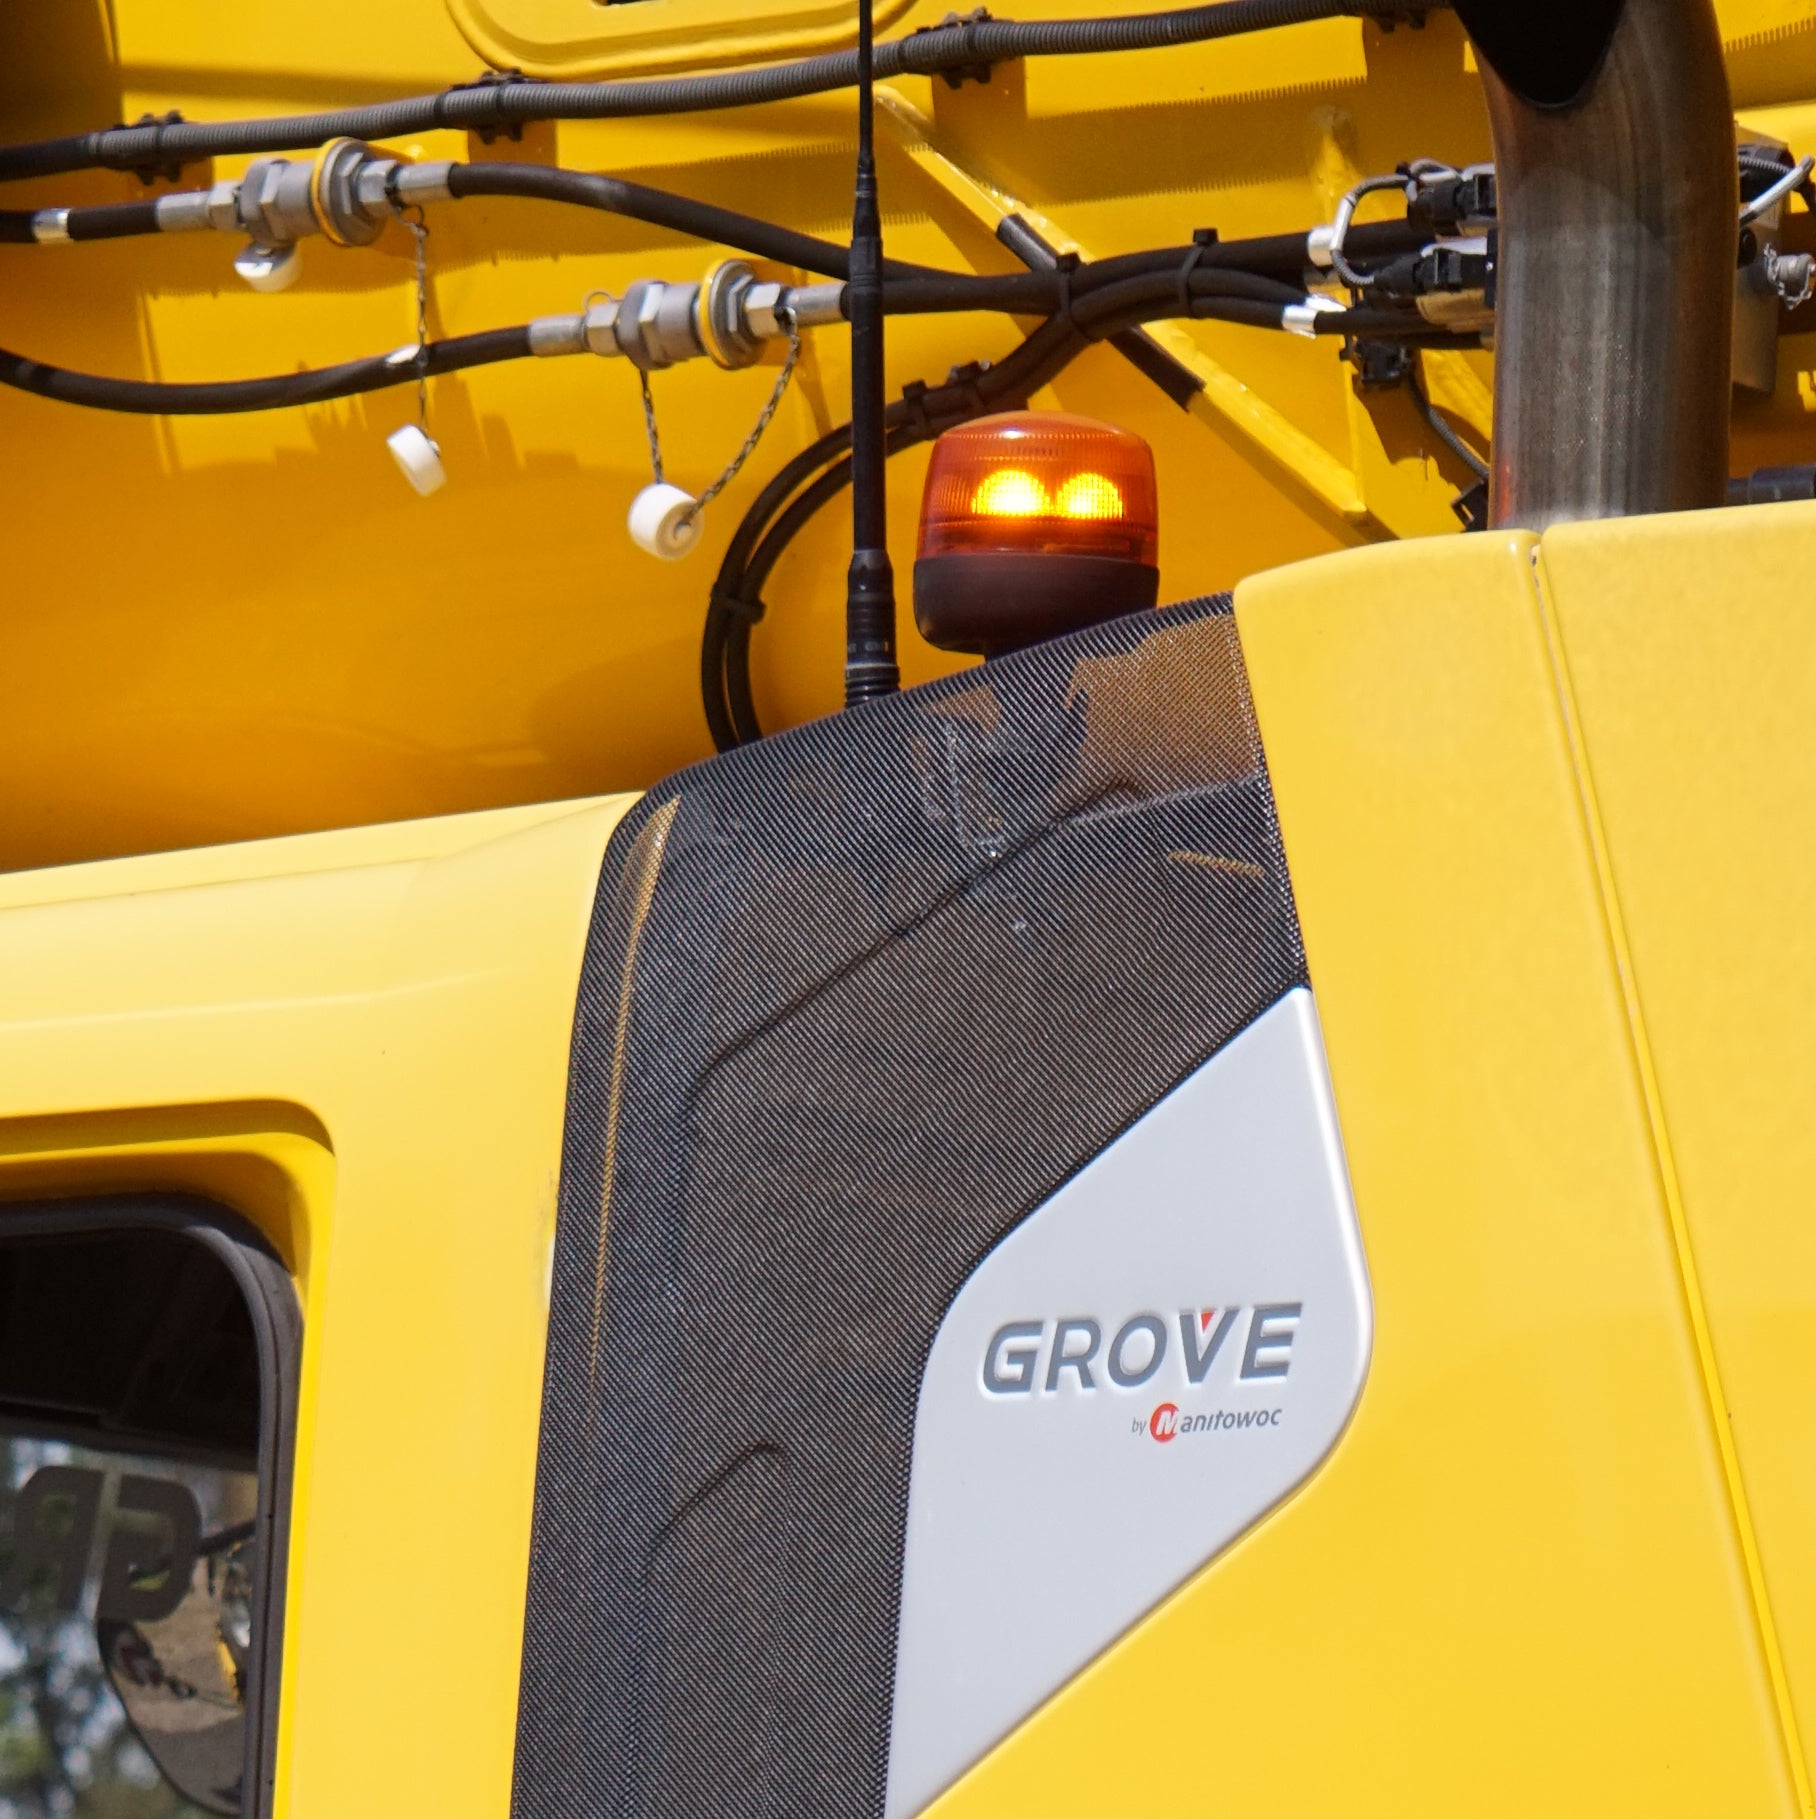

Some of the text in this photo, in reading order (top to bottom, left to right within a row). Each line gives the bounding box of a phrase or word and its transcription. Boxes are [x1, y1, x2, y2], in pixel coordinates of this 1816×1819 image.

[981, 1302, 1302, 1393] GROVE
[1131, 1402, 1283, 1443] by Manitowoc
